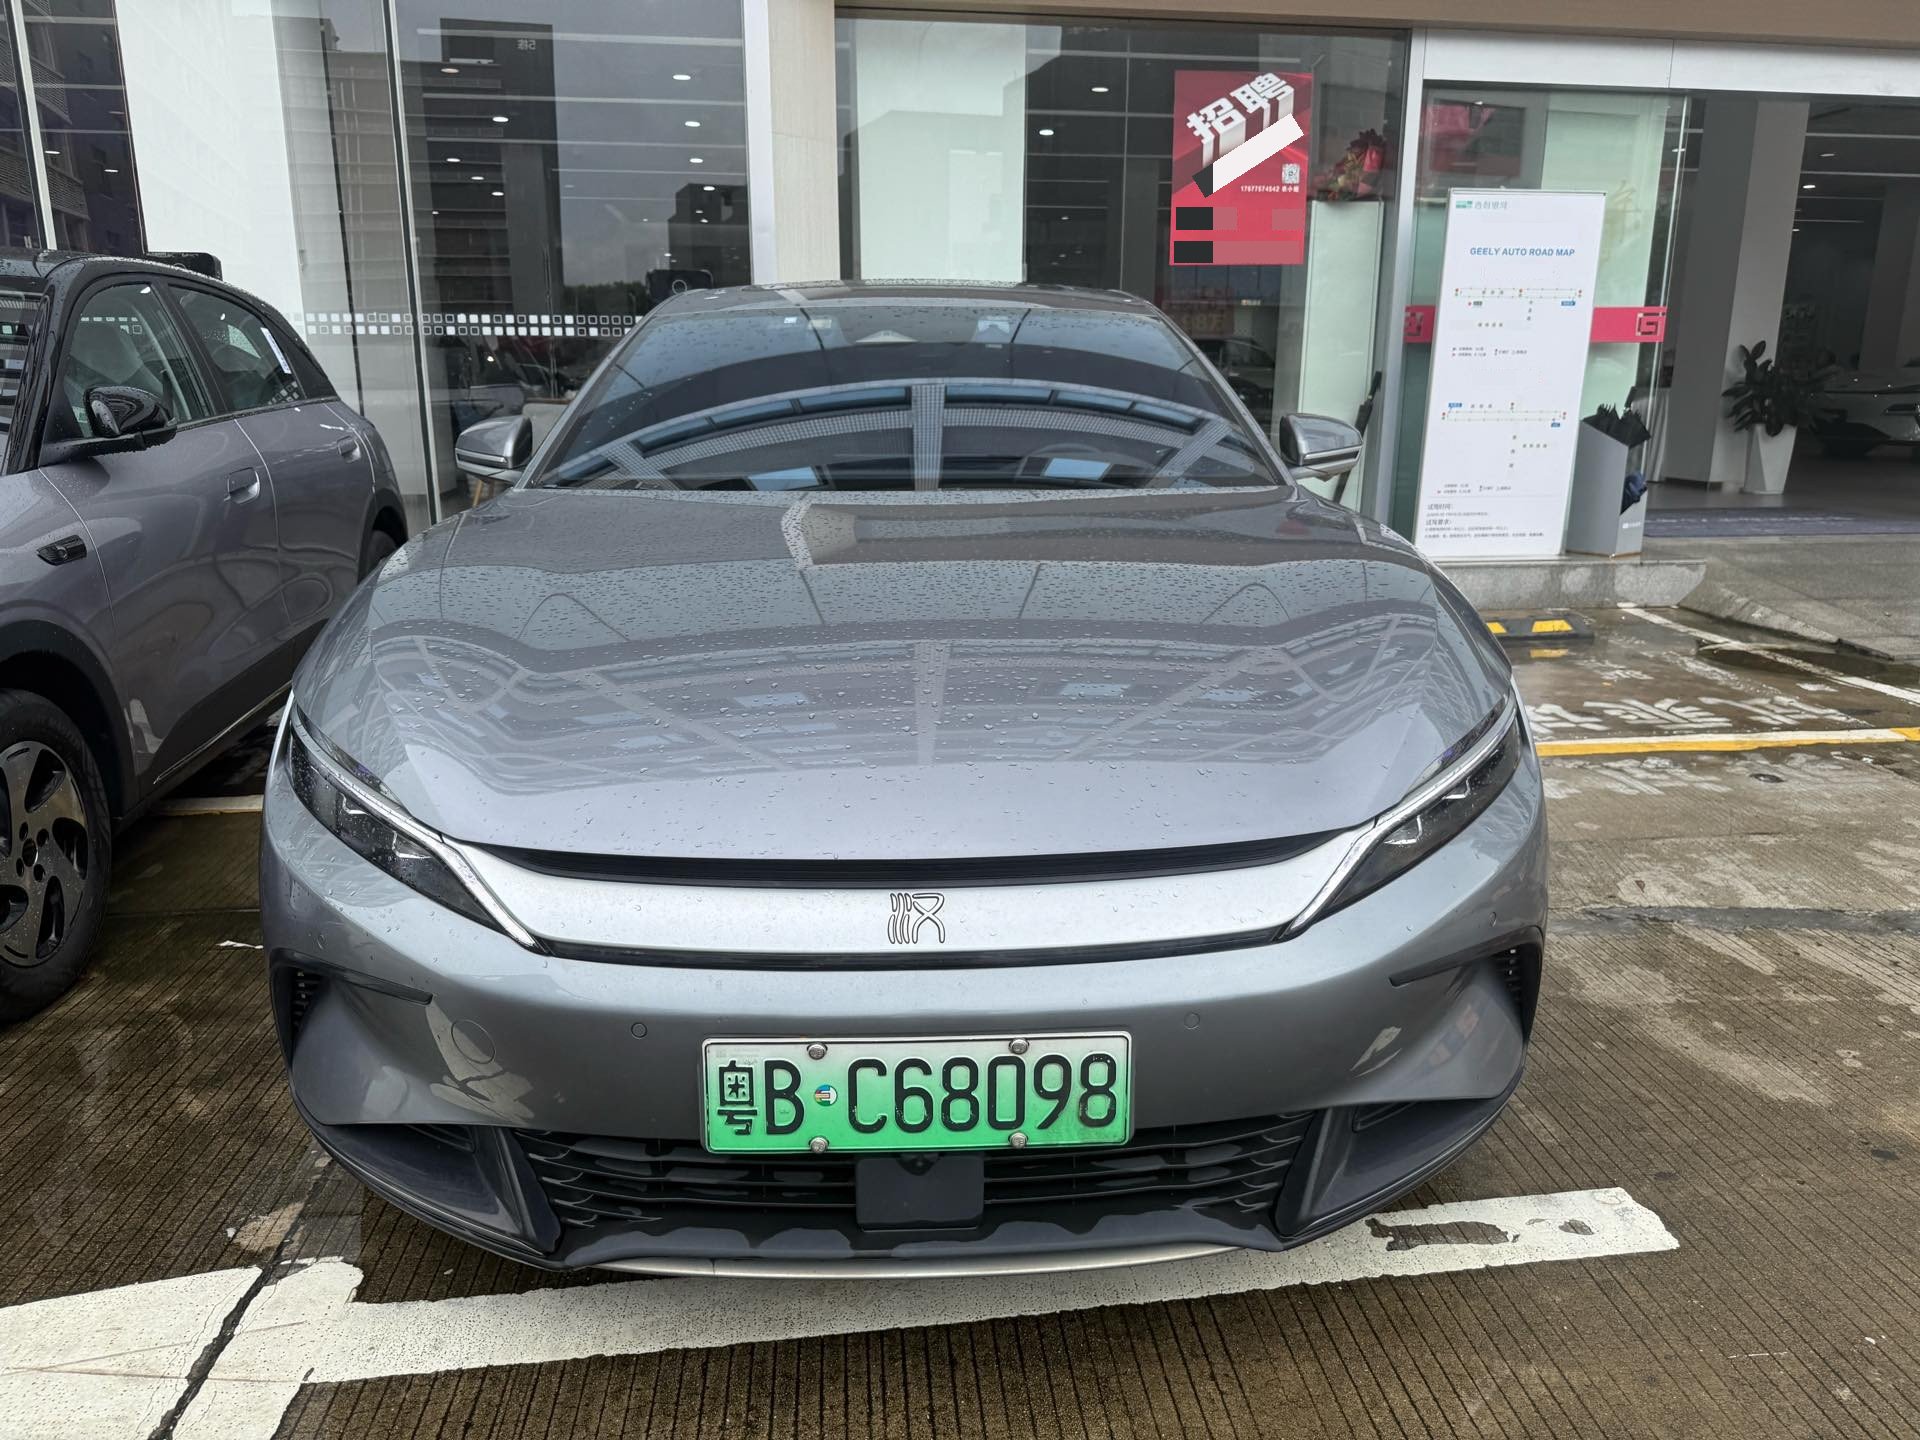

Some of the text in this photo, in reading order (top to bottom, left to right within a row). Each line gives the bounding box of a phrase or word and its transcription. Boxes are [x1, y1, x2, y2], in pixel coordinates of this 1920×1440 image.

[1186, 72, 1294, 145] 招聘
[1469, 247, 1575, 257] GEELY AUTO ROAD MAP
[847, 1053, 1118, 1134] C68098
